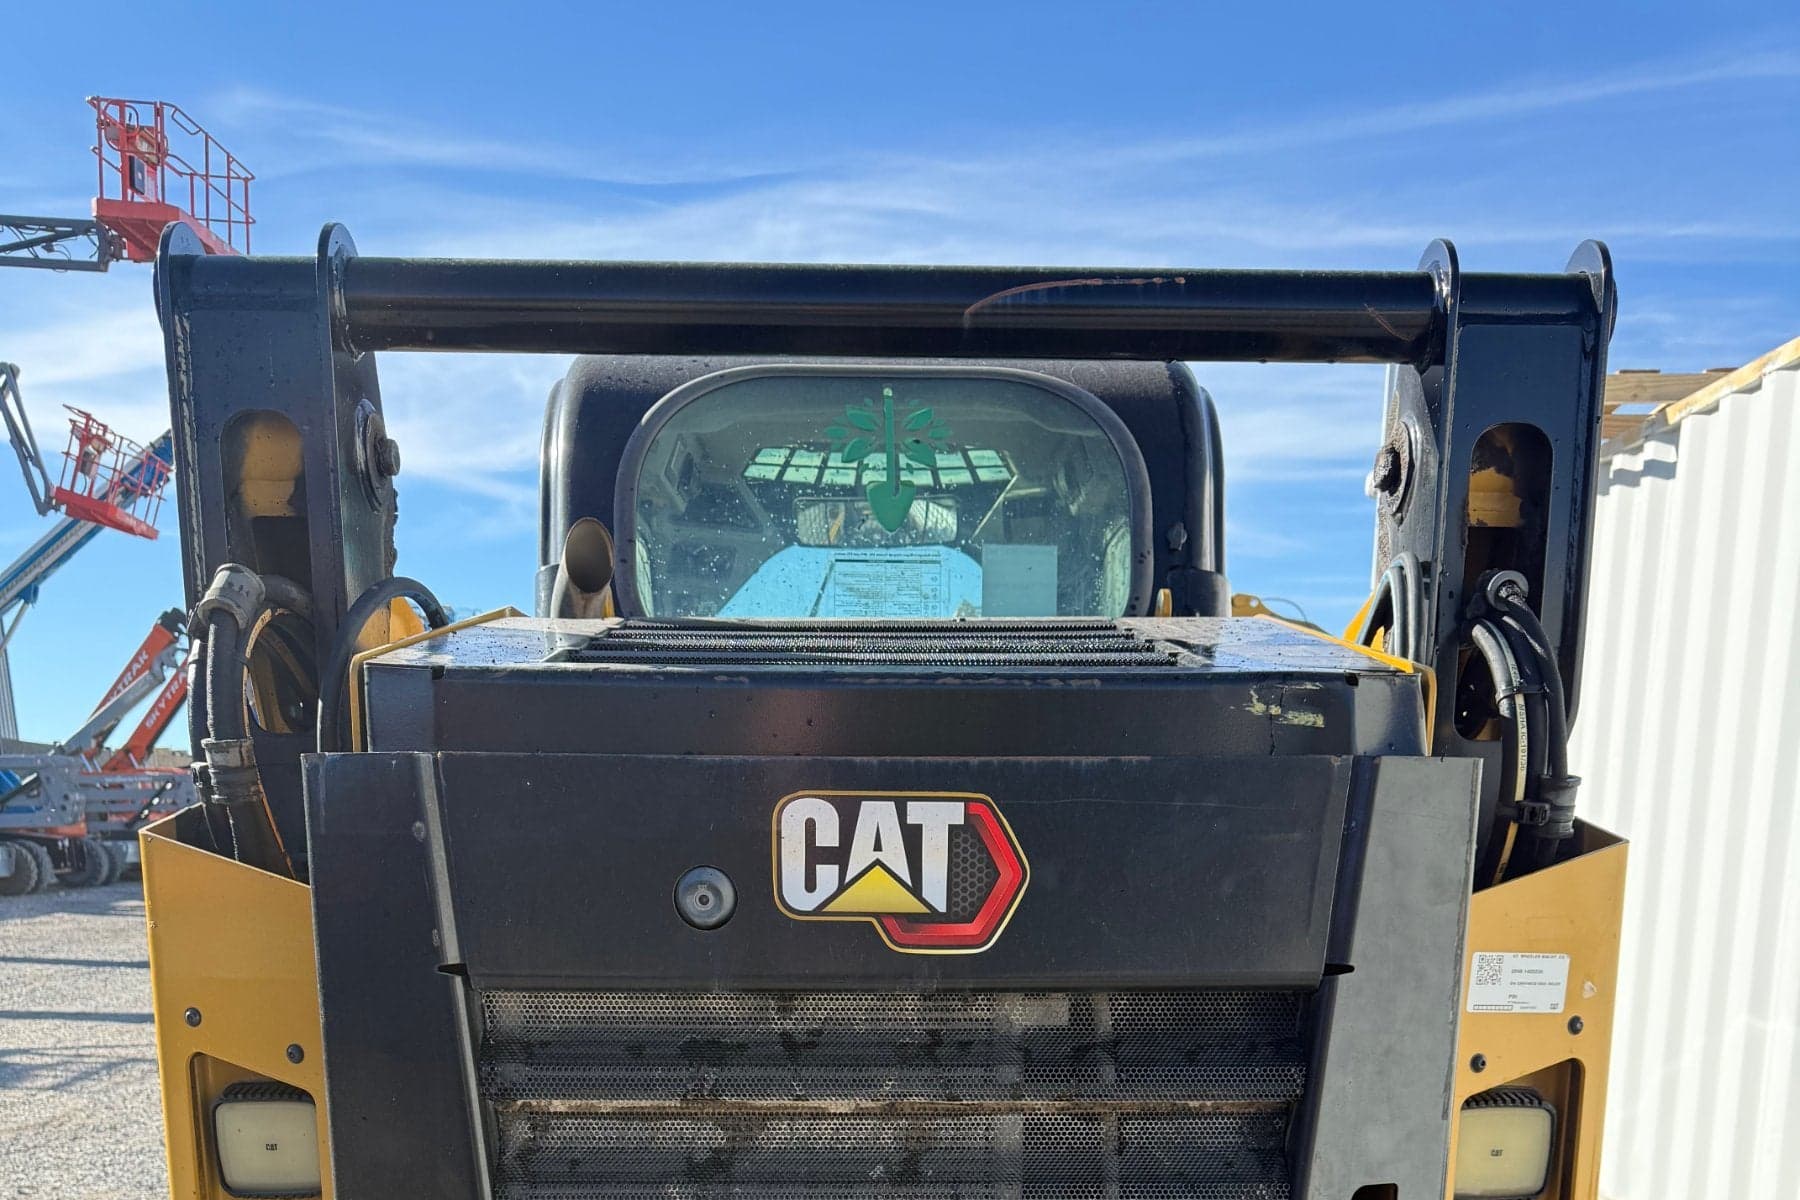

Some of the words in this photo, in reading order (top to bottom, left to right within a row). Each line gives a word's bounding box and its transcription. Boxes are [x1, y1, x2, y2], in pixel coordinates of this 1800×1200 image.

[145, 671, 188, 728] SKYTRA
[781, 798, 964, 913] CAT
[265, 1143, 278, 1151] CAT
